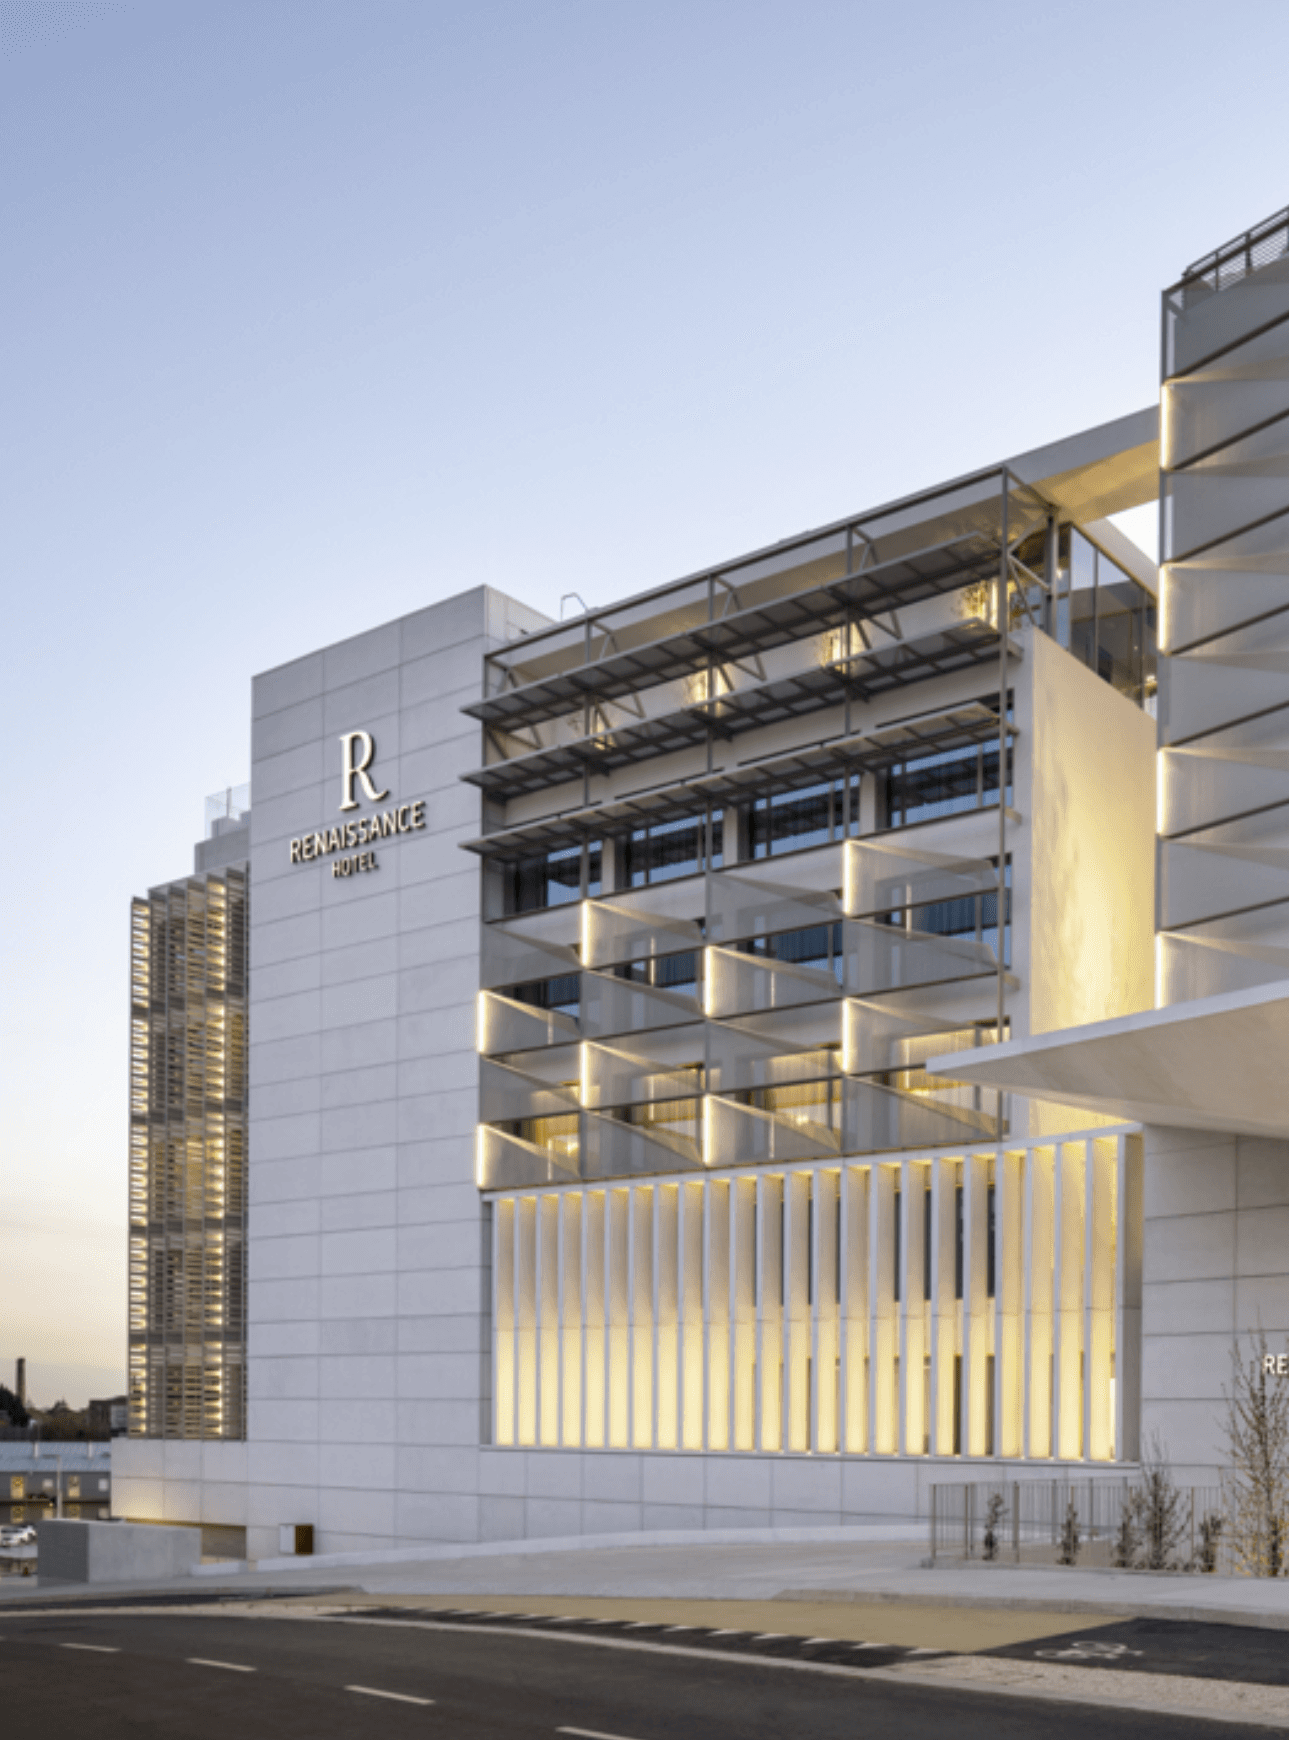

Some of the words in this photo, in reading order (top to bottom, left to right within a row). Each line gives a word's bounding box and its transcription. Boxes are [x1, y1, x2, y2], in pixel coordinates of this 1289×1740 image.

[339, 729, 390, 811] R
[290, 801, 425, 863] RENAISSANCE
[332, 852, 378, 878] HOTEL
